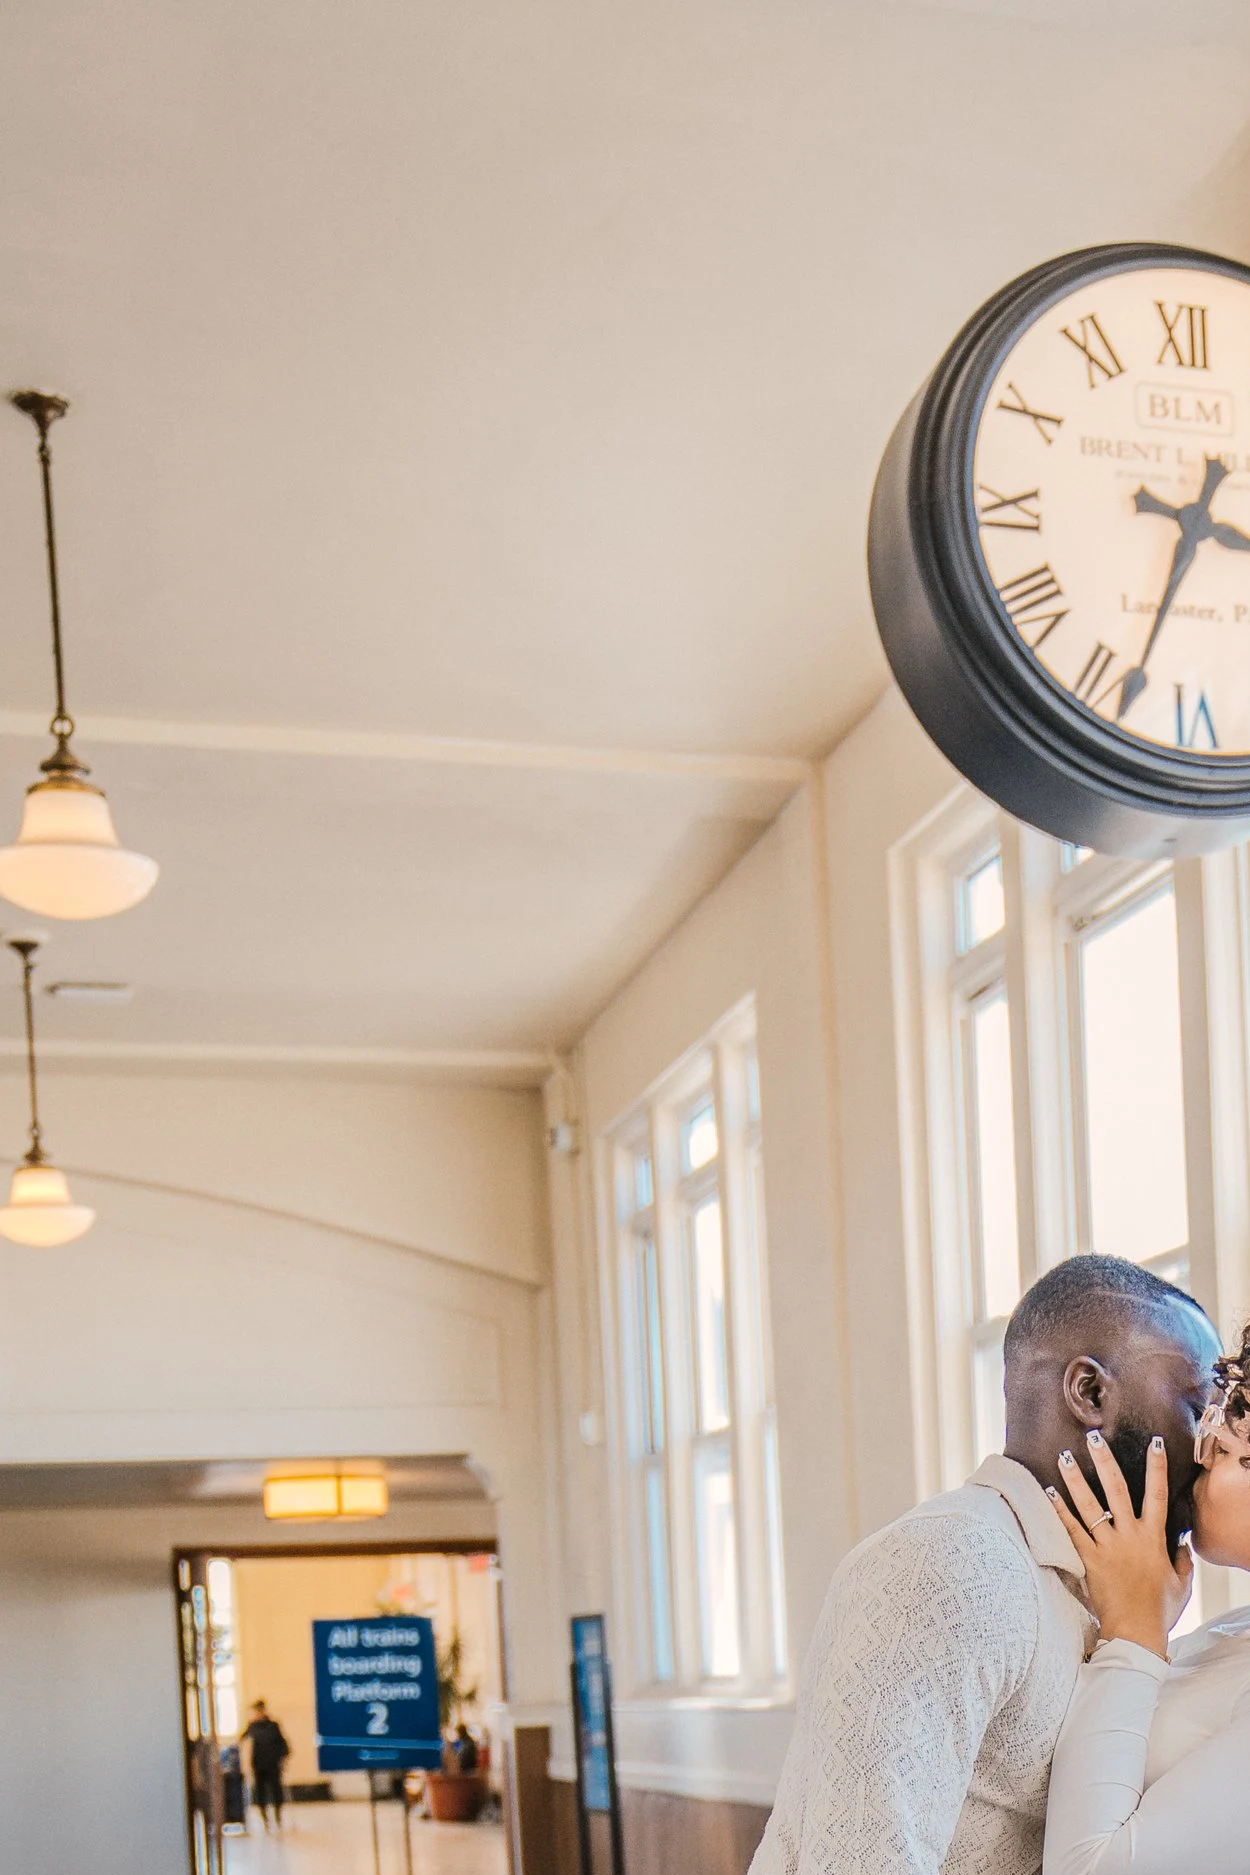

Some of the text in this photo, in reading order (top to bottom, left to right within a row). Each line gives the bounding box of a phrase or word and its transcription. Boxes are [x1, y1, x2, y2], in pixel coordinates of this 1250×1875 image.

[1058, 312, 1126, 389] XI
[1154, 300, 1209, 369] XII
[996, 381, 1064, 446] X
[1148, 393, 1223, 425] BLM
[1079, 434, 1166, 463] BRENT
[979, 484, 1041, 533] IX
[996, 561, 1072, 650] VIII
[1121, 592, 1225, 624] Lanaster,
[1173, 682, 1219, 749] VI
[328, 1625, 420, 1648] All trains
[328, 1653, 422, 1678] boarding
[331, 1678, 421, 1702] Platform
[366, 1702, 389, 1735] 2
